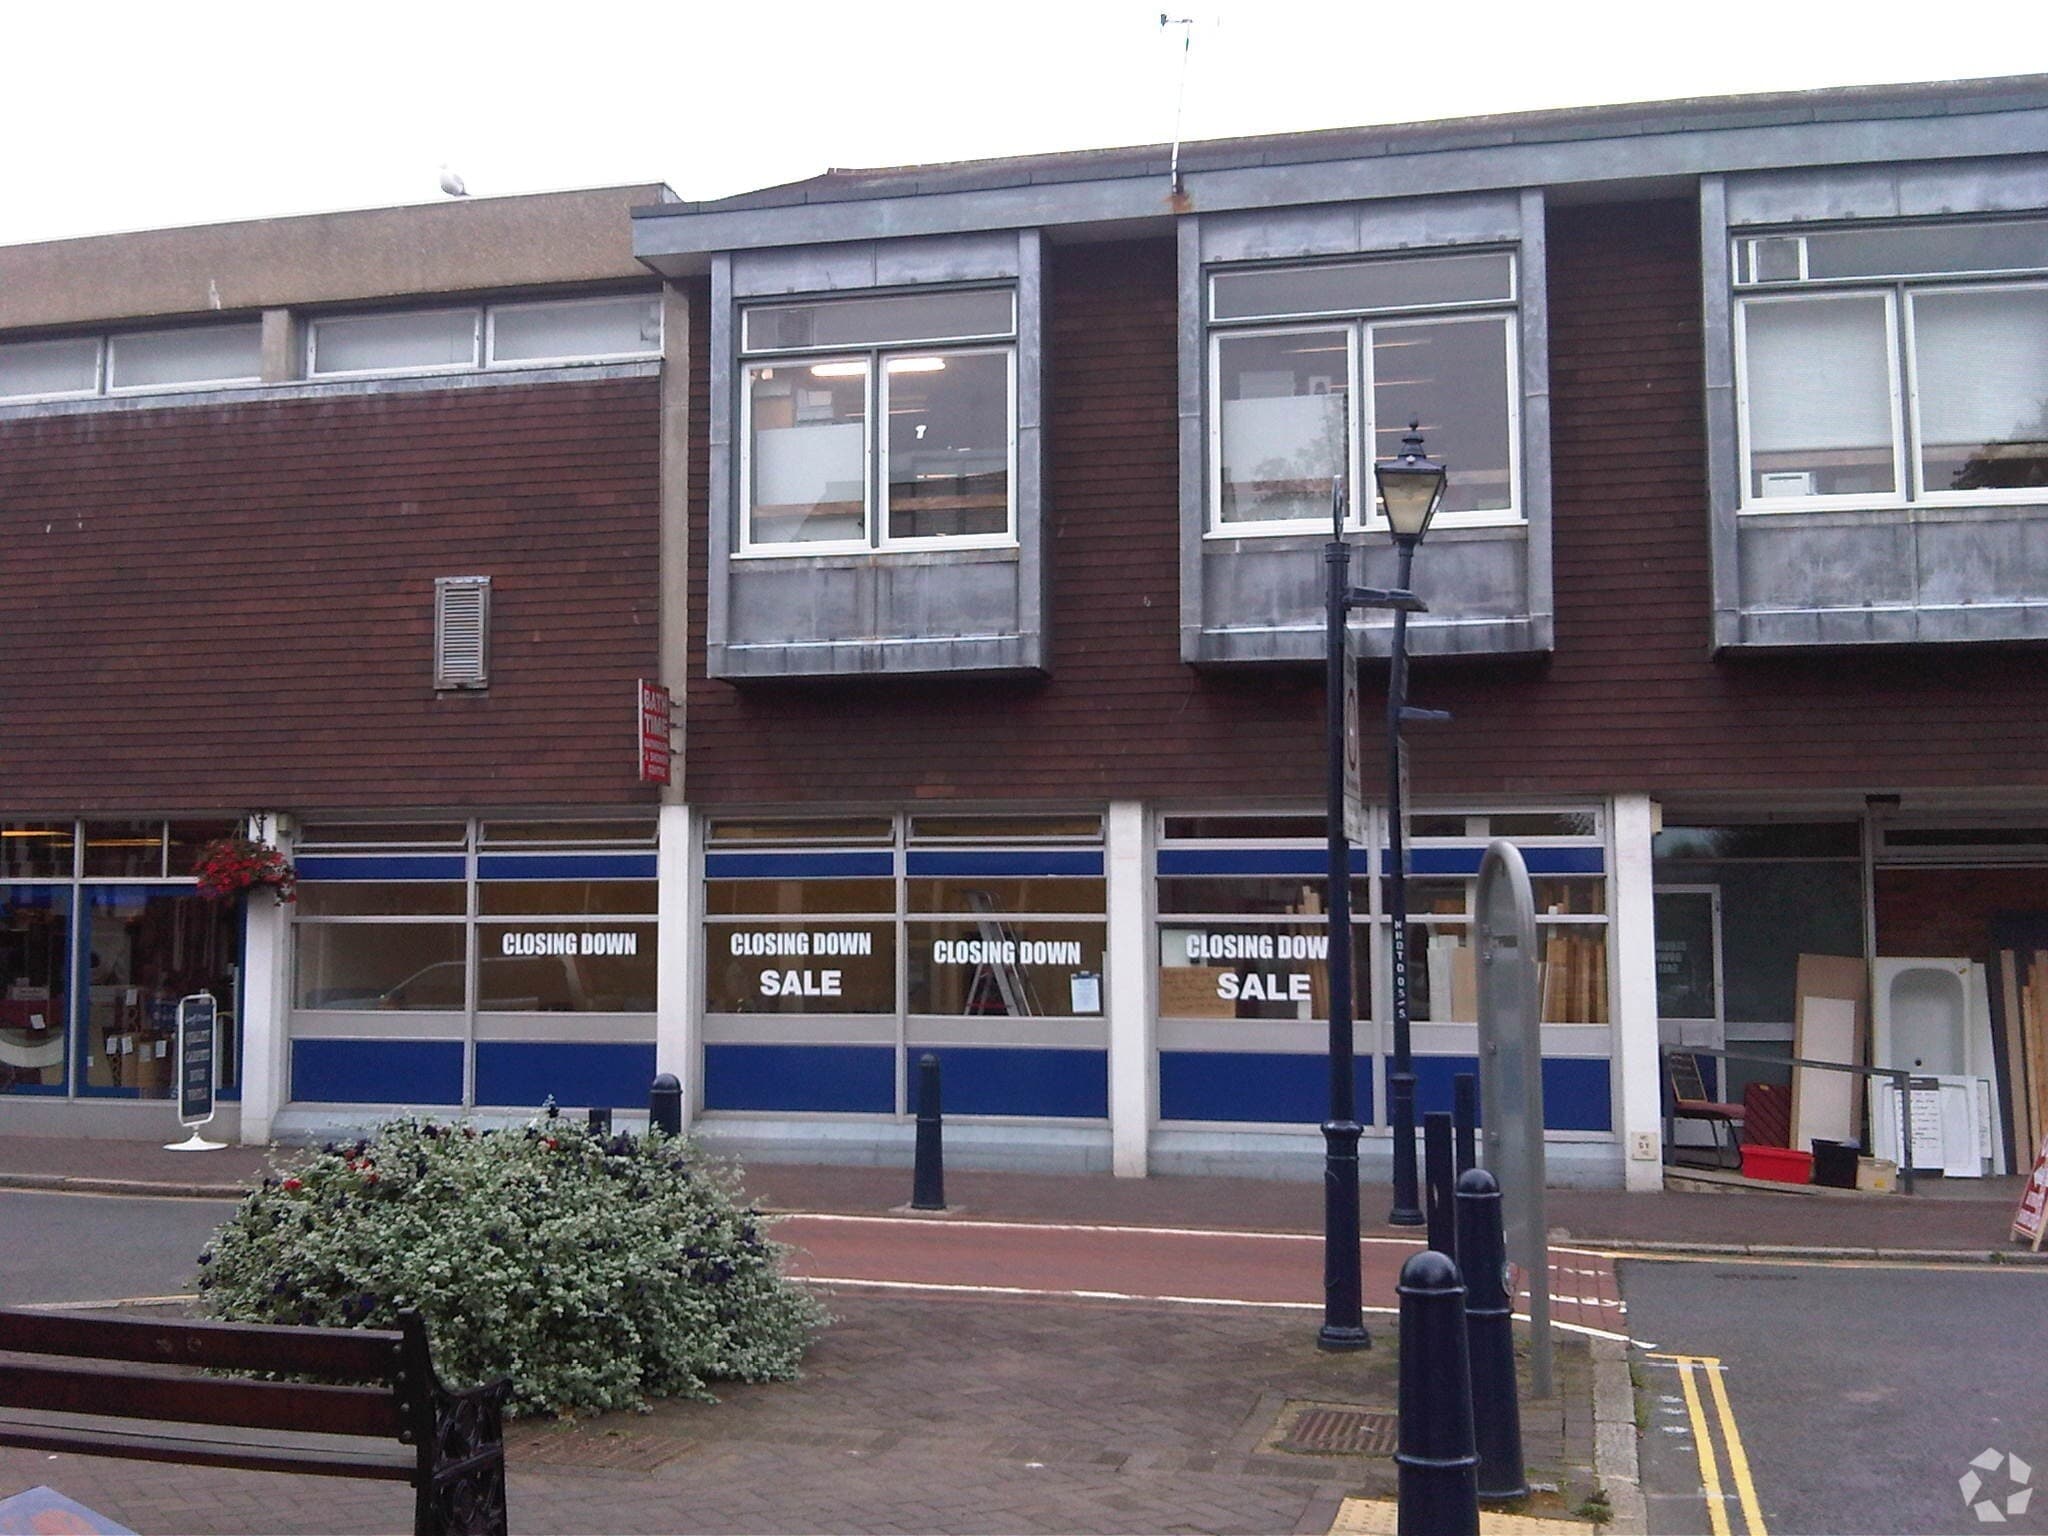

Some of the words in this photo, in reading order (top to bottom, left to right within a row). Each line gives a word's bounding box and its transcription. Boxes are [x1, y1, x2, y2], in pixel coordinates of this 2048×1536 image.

[502, 932, 578, 955] CLOSING
[581, 932, 637, 955] DOWN
[730, 932, 809, 956] CLOSING
[813, 932, 872, 956] DOWN
[933, 940, 1016, 964] CLOSING
[1019, 941, 1081, 965] DOWN
[1186, 934, 1274, 959] CLOSING
[1278, 935, 1329, 960] DOW
[760, 970, 842, 996] SALE
[1216, 972, 1312, 1001] SALE
